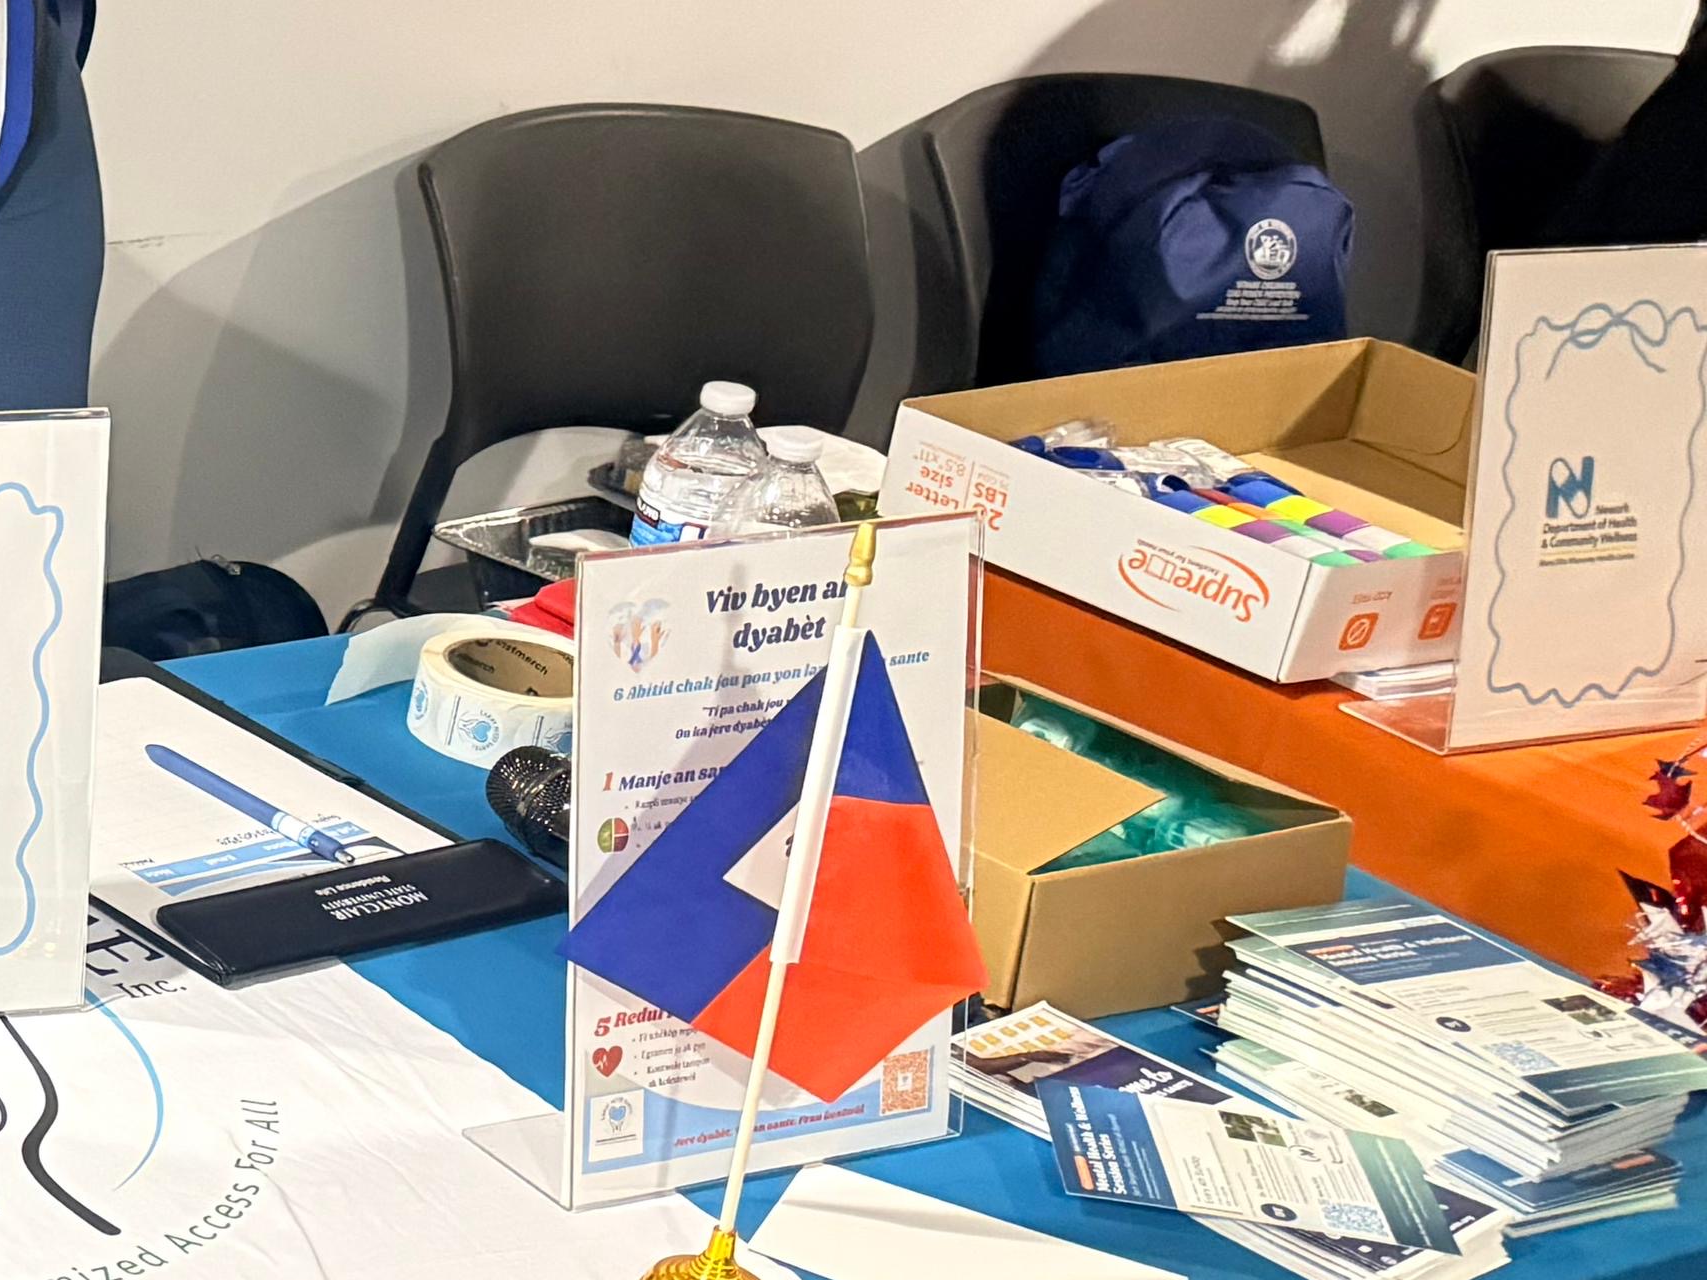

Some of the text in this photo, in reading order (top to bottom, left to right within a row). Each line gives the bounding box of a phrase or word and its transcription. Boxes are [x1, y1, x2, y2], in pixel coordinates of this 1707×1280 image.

[920, 465, 955, 489] size
[906, 481, 960, 510] Letter
[973, 482, 1008, 508] LBS
[705, 585, 746, 615] Viv
[750, 576, 818, 614] byen
[732, 612, 826, 655] dyabèt
[889, 649, 930, 667] sante
[613, 688, 624, 703] 6
[626, 680, 673, 701] Abitid
[675, 675, 713, 695] chak
[714, 671, 739, 692] jou
[602, 769, 694, 796] 1 Manje an
[322, 883, 416, 911] STATE UNIVERSITY
[329, 891, 429, 921] MONTCLAIR
[113, 979, 188, 999] Inc.
[594, 1016, 610, 1038] 5
[240, 1097, 281, 1135] All
[235, 1138, 280, 1175] For
[165, 1170, 263, 1256] Access
